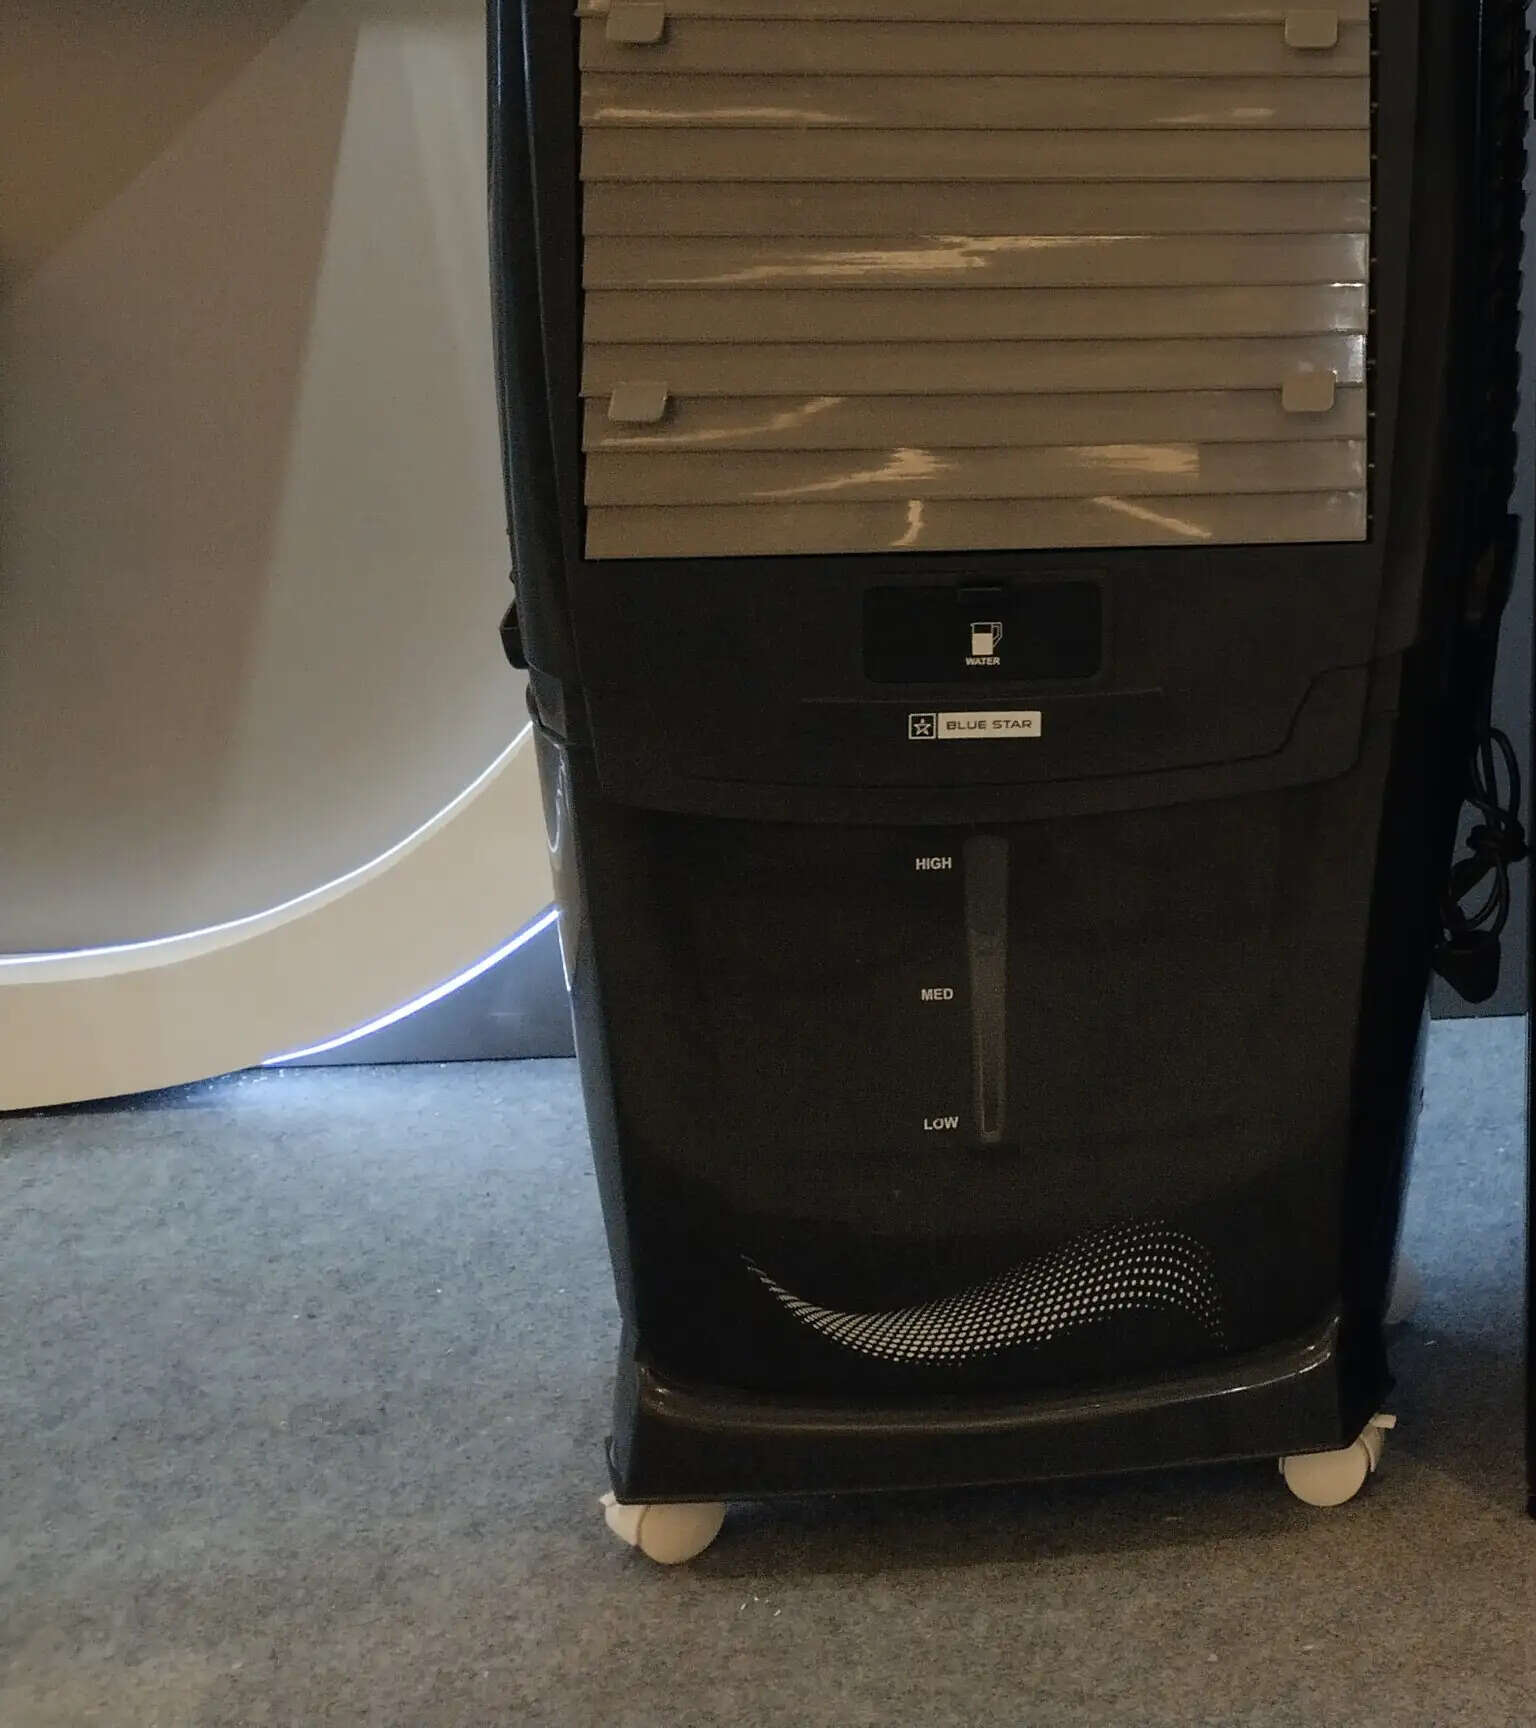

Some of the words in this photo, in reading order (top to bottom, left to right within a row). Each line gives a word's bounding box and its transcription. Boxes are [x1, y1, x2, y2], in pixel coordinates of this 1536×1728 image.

[965, 657, 1001, 666] WATER
[946, 720, 987, 730] BLUE
[992, 719, 1033, 730] STAR
[915, 856, 952, 870] HIGH
[921, 988, 954, 1002] MED
[923, 1115, 959, 1131] LOW
